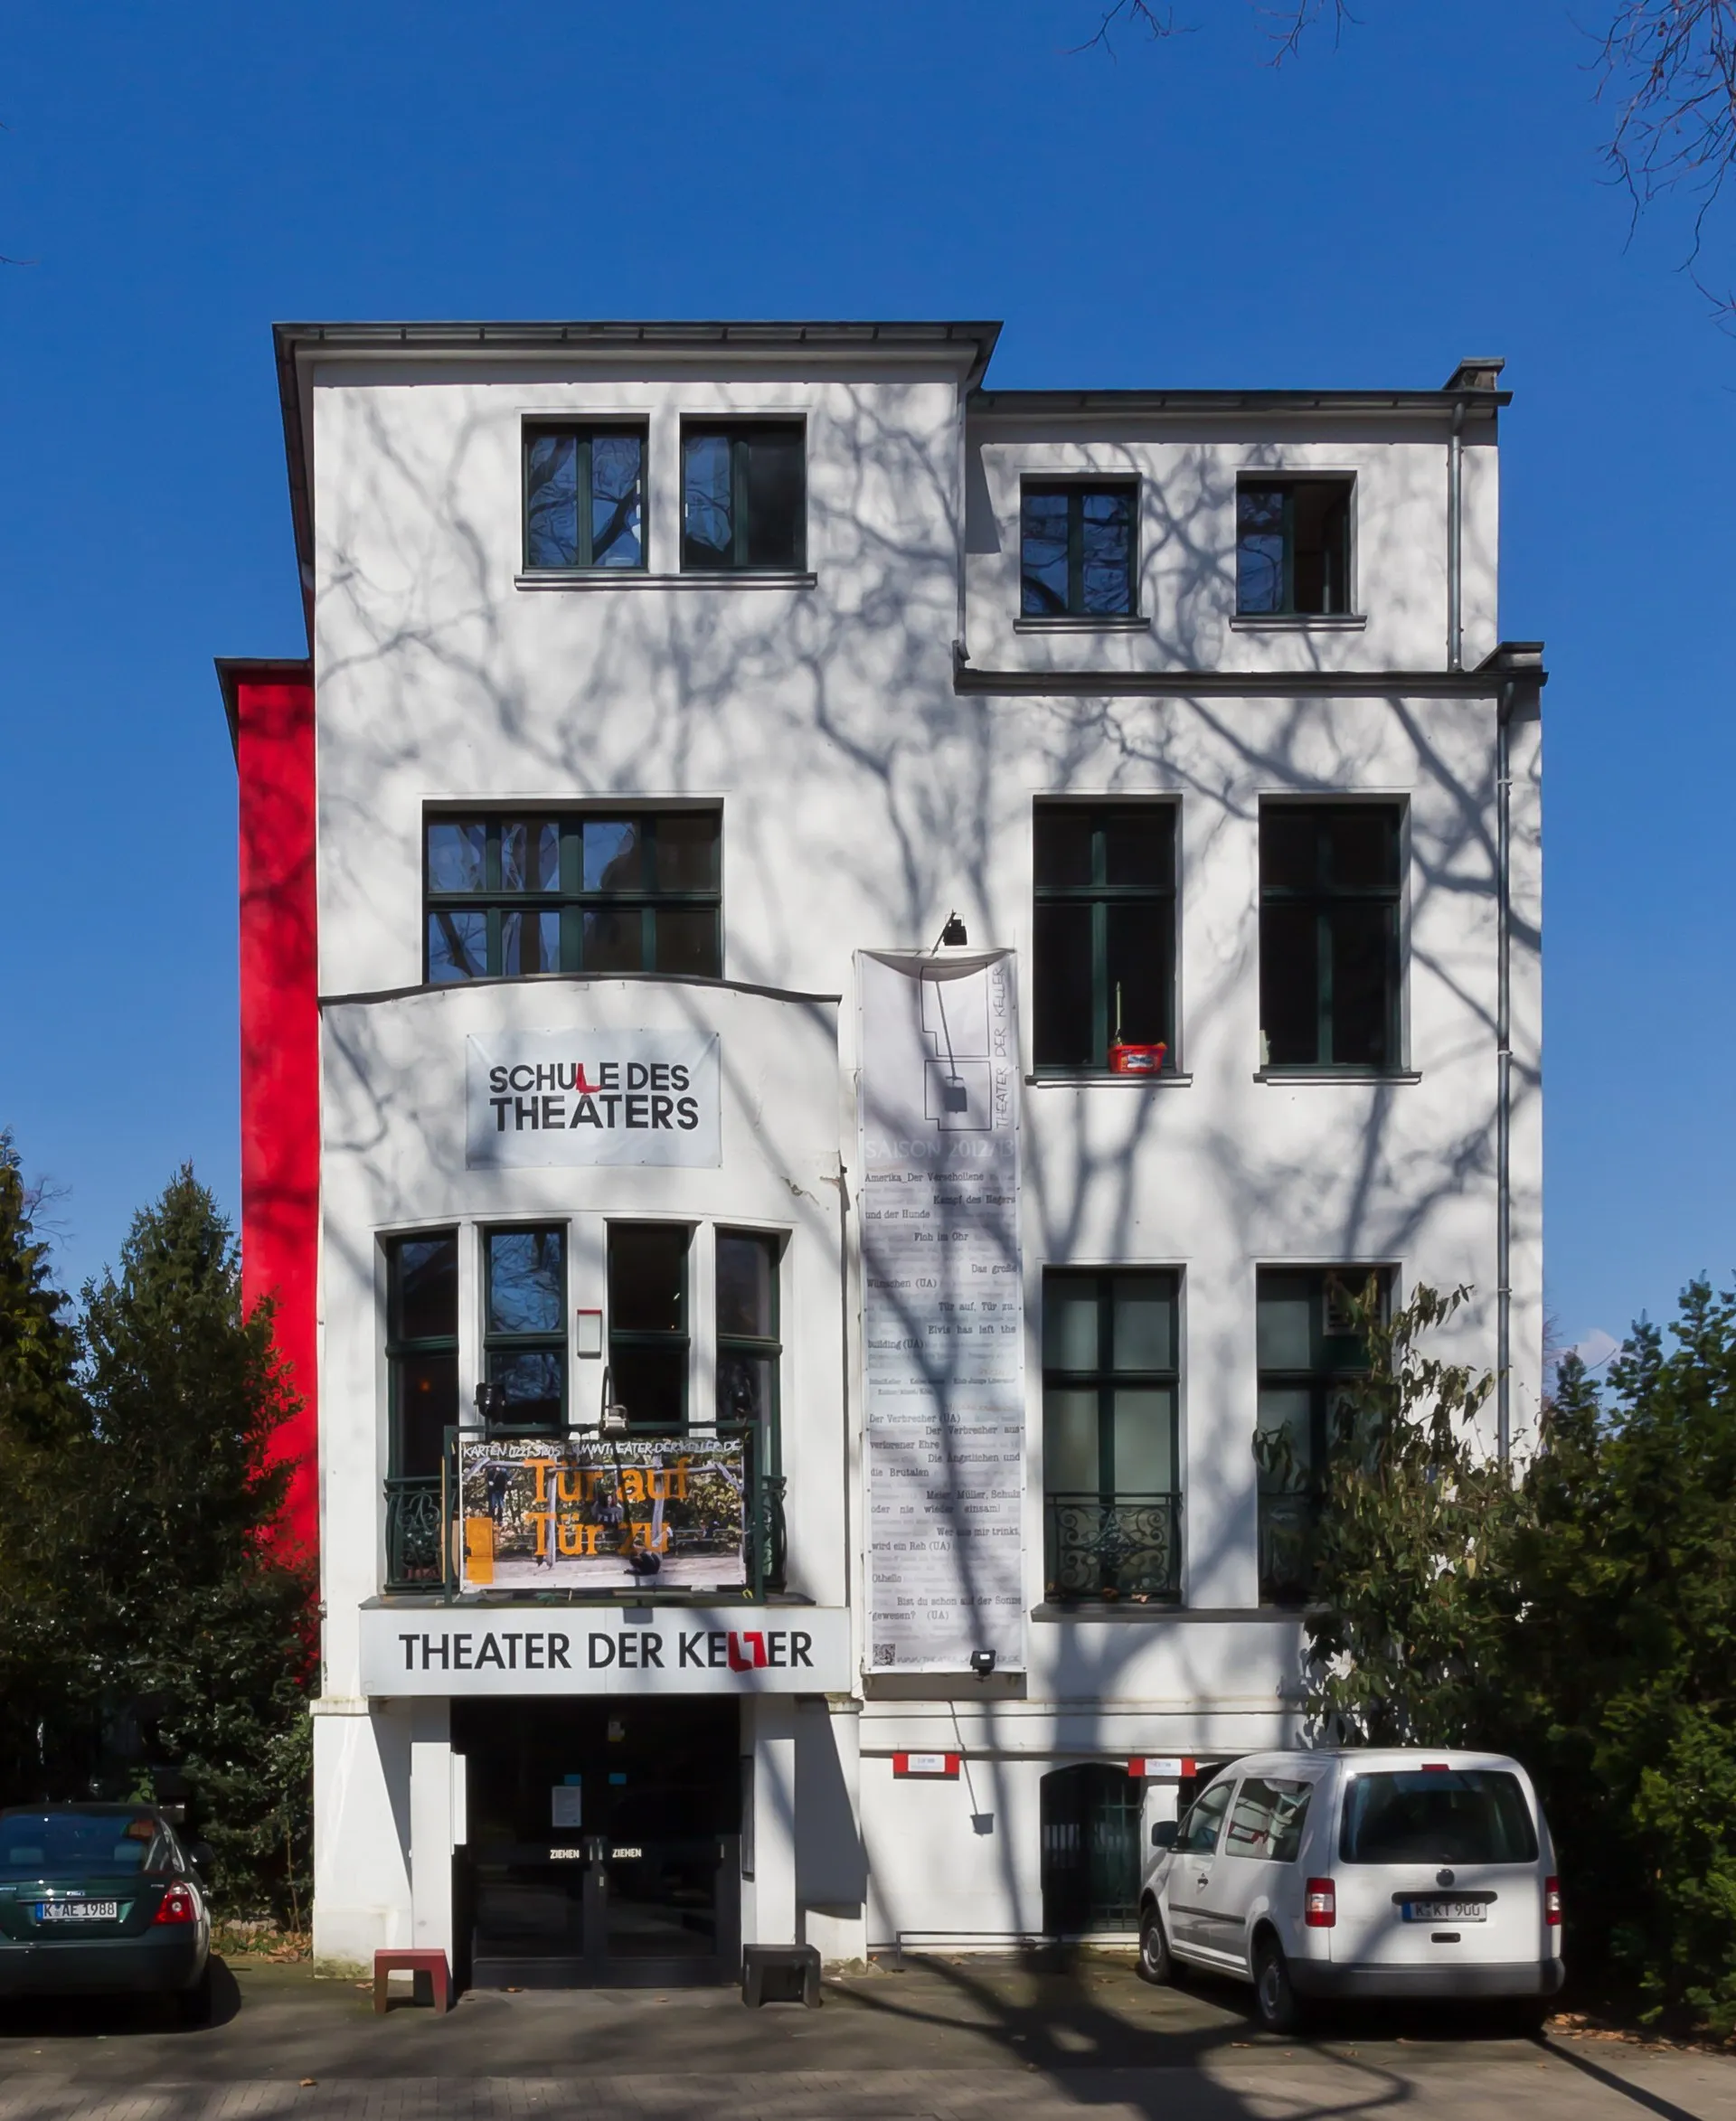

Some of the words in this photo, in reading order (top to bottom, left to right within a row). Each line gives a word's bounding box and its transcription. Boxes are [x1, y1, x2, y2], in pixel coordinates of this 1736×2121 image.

[993, 967, 1006, 1018] KELLER
[995, 1027, 1006, 1058] DER
[489, 1062, 619, 1094] SCHULE
[627, 1062, 690, 1091] DES
[489, 1093, 699, 1132] THEATERS
[996, 1066, 1009, 1129] THEATER
[865, 1139, 941, 1159] SAISON
[884, 1210, 899, 1220] der
[869, 1413, 884, 1423] Der
[463, 1444, 507, 1458] KARTEN
[524, 1458, 603, 1503] Tür
[617, 1456, 690, 1502] auf
[524, 1512, 604, 1556] Tür
[618, 1521, 670, 1555] zu
[399, 1632, 571, 1670] THEATER
[588, 1631, 665, 1669] DER
[679, 1631, 815, 1673] KELLER
[550, 1849, 580, 1859] ZIEHEN
[612, 1848, 642, 1858] ZIEHEN
[61, 1902, 80, 1917] AE
[83, 1901, 115, 1916] 1988
